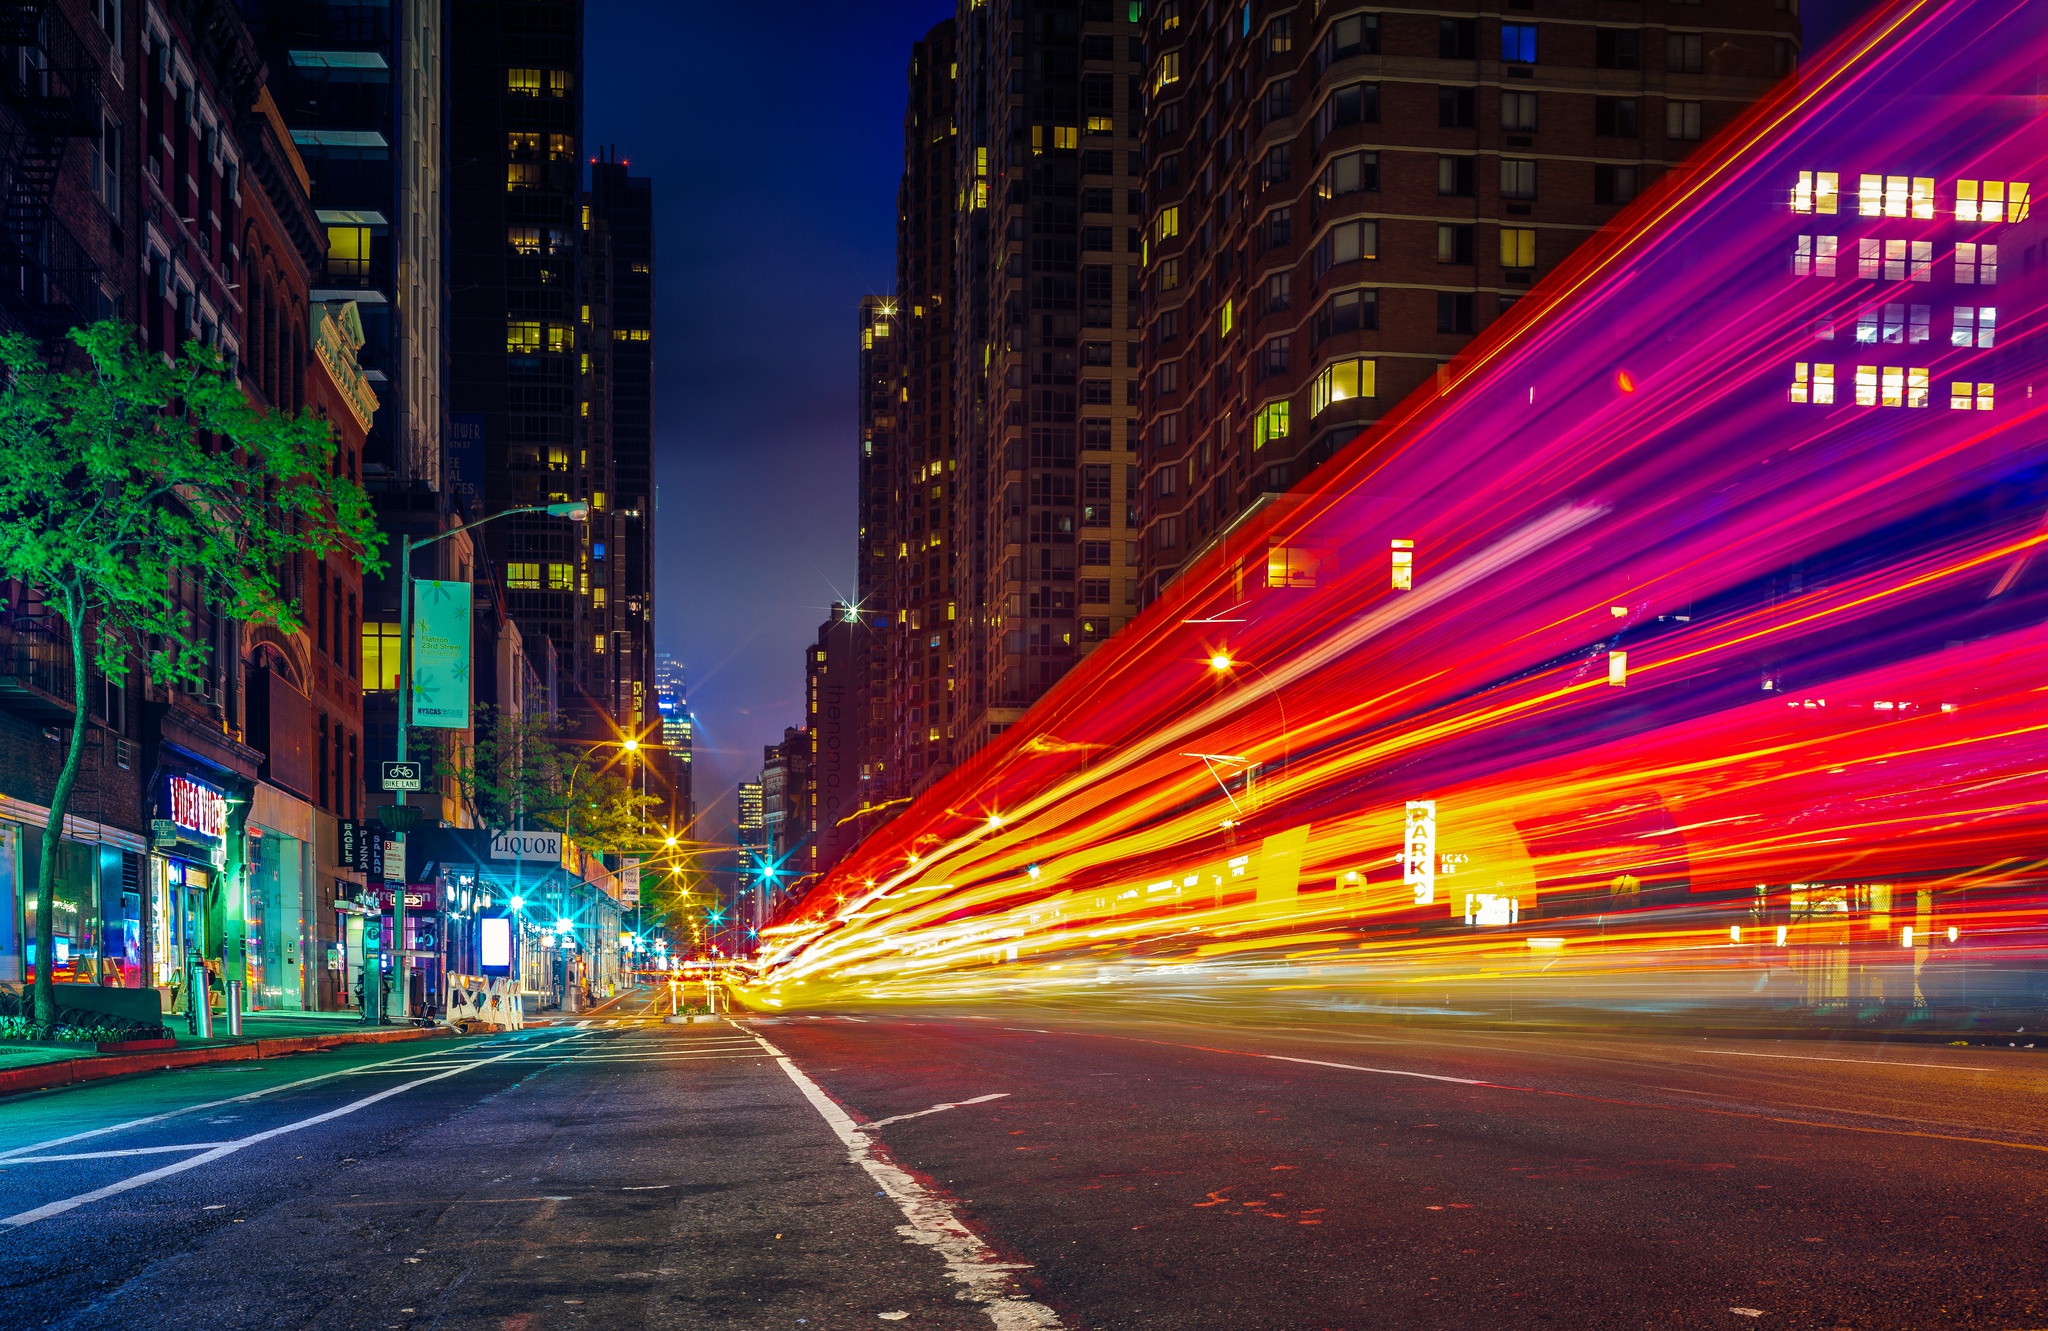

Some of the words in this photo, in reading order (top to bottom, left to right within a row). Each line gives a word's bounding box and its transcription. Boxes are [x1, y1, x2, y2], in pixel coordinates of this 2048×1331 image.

[421, 635, 449, 643] Flatiron
[439, 643, 462, 651] Street
[417, 707, 442, 716] NYSCAS
[385, 780, 399, 788] BIKE
[401, 780, 418, 788] LANE
[172, 778, 200, 829] VIDEO
[343, 823, 353, 863] BAGELS
[360, 830, 369, 870] PIZZA
[494, 836, 557, 856] LIQUOR
[373, 835, 381, 874] SALAD
